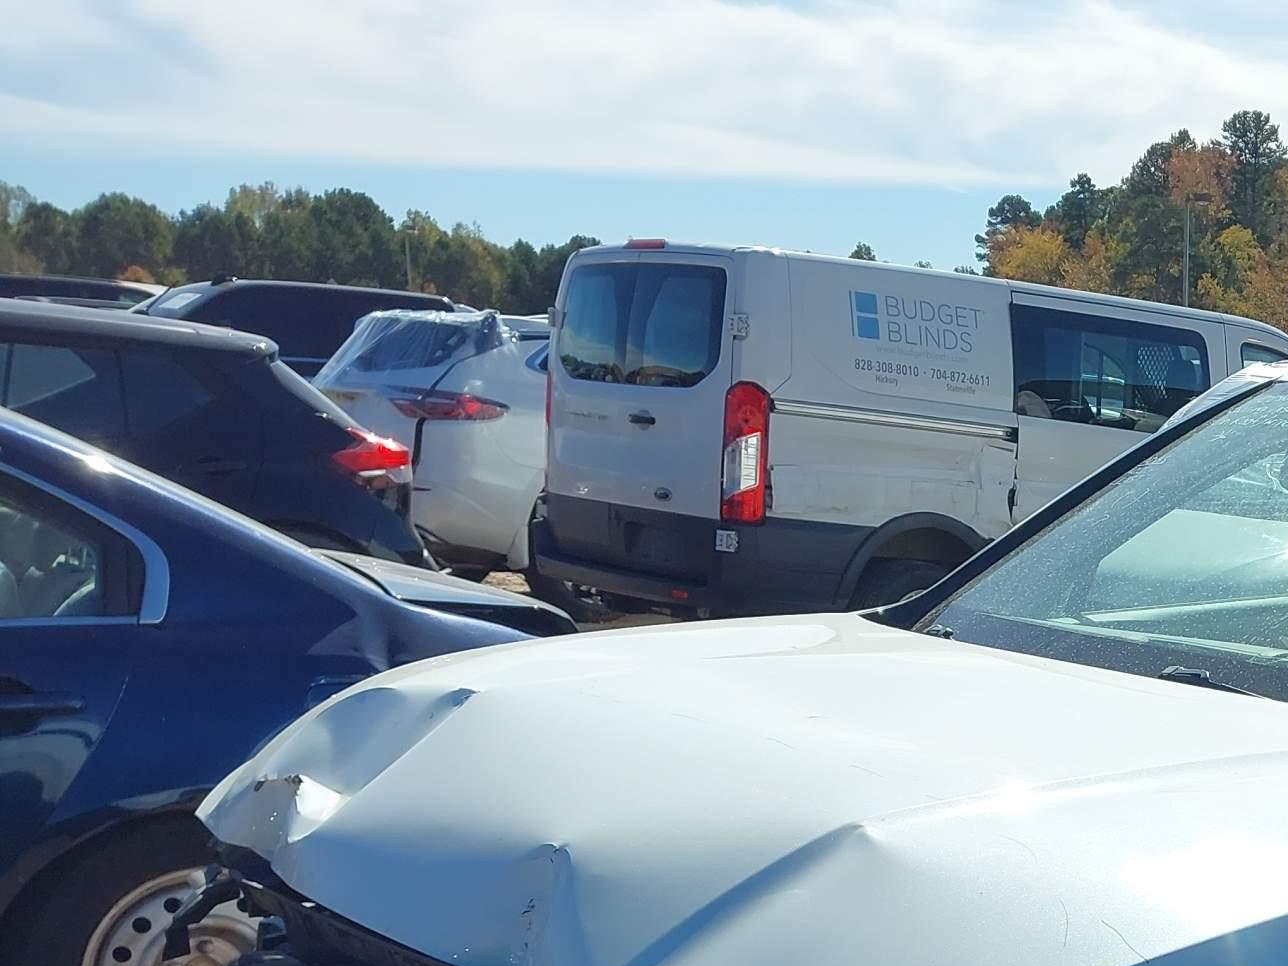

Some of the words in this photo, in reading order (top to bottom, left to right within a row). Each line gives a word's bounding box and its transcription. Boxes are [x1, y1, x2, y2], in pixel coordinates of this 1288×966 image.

[885, 295, 981, 329] BUDGET
[887, 321, 973, 353] BLINDS
[854, 358, 919, 377] 828-308-8010
[930, 367, 990, 387] 704-872-6611
